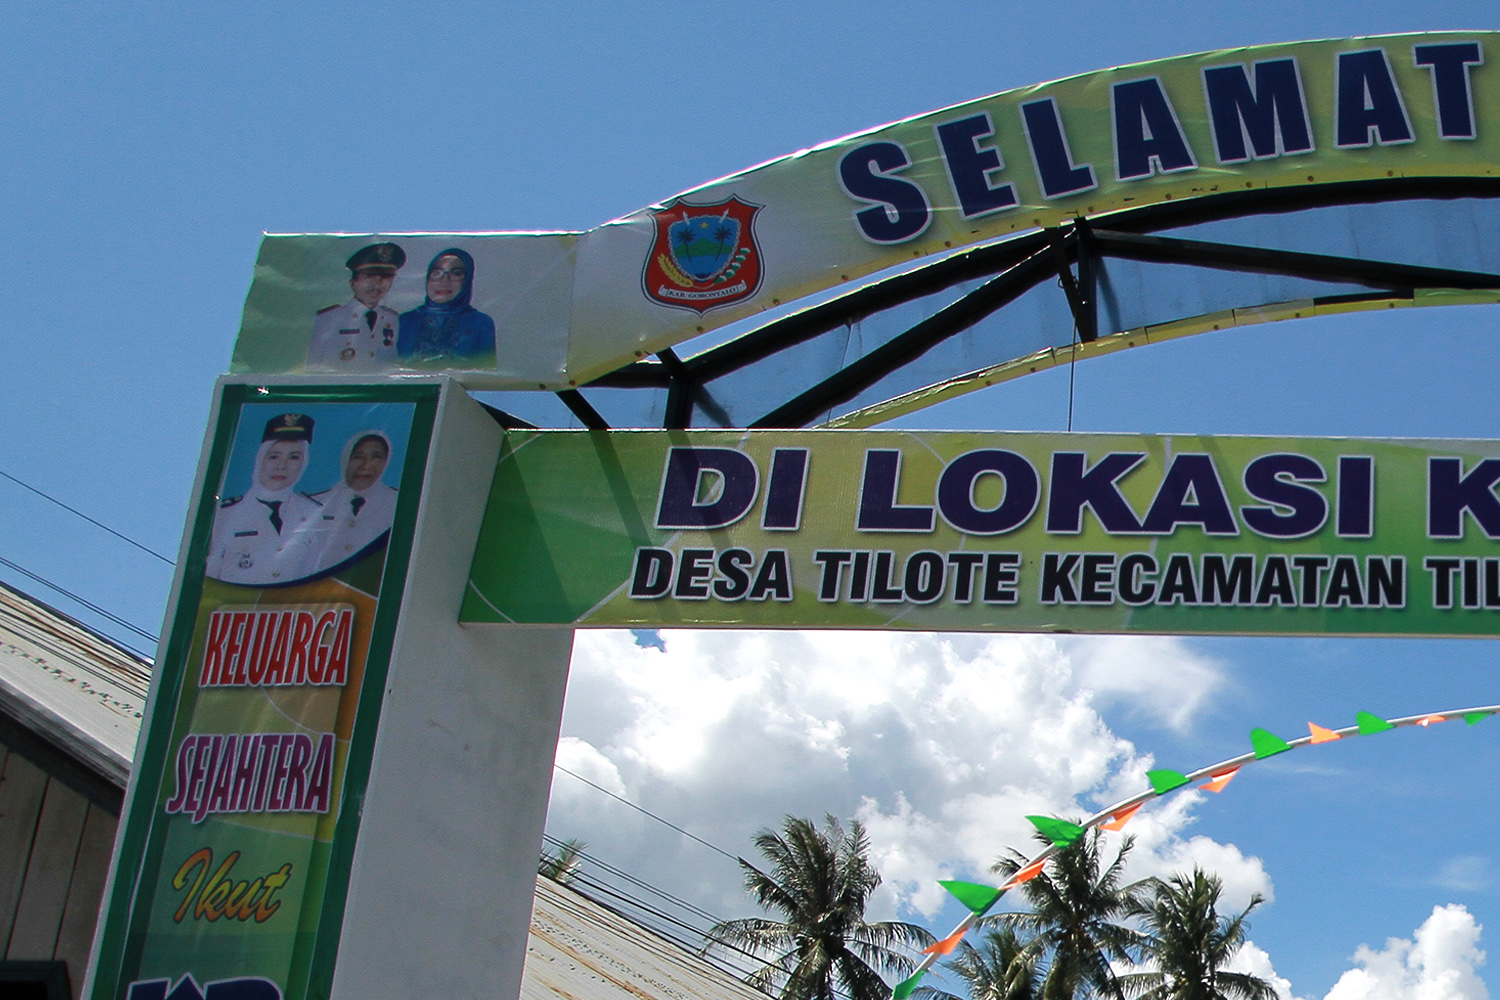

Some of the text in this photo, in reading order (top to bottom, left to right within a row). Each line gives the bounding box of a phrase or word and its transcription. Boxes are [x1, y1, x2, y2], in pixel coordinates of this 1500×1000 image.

[837, 41, 1484, 245] SELAMAT
[688, 287, 736, 299] GORONTALO
[654, 446, 810, 531] DI
[855, 448, 1375, 538] LOKASI
[630, 547, 794, 601] DESA
[814, 549, 1021, 604] TILOTE
[1039, 551, 1407, 609] KECAMATAN
[199, 609, 355, 688] KELUARGA
[165, 732, 335, 824] SEJAHTERA
[172, 847, 293, 924] Ikut
